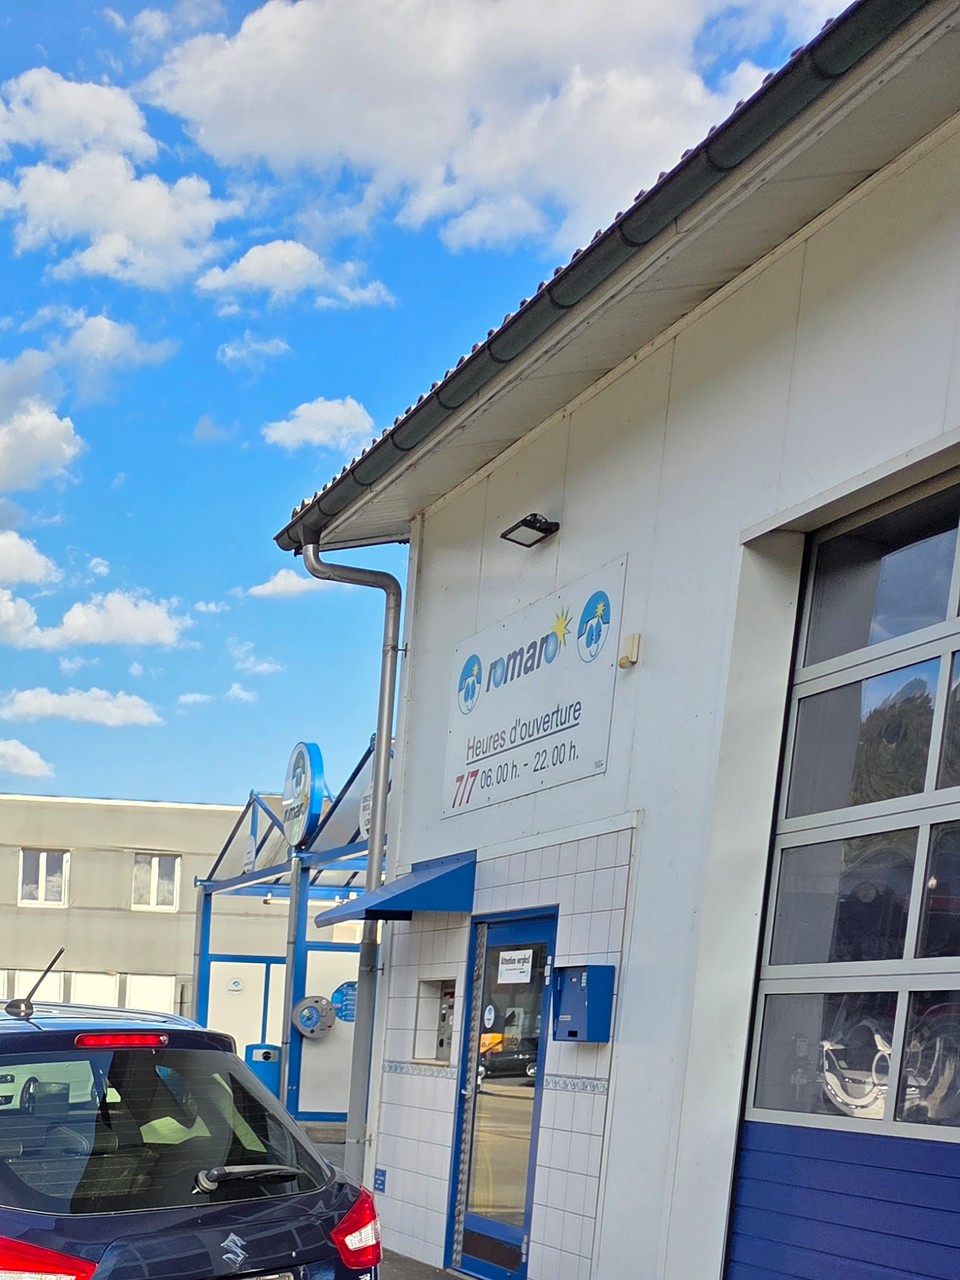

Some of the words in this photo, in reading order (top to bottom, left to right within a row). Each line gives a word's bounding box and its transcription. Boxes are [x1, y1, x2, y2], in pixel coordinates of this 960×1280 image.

[486, 631, 559, 693] romaro
[466, 730, 507, 761] Heures
[509, 700, 582, 745] d'ouverture
[451, 768, 480, 809] 7/7
